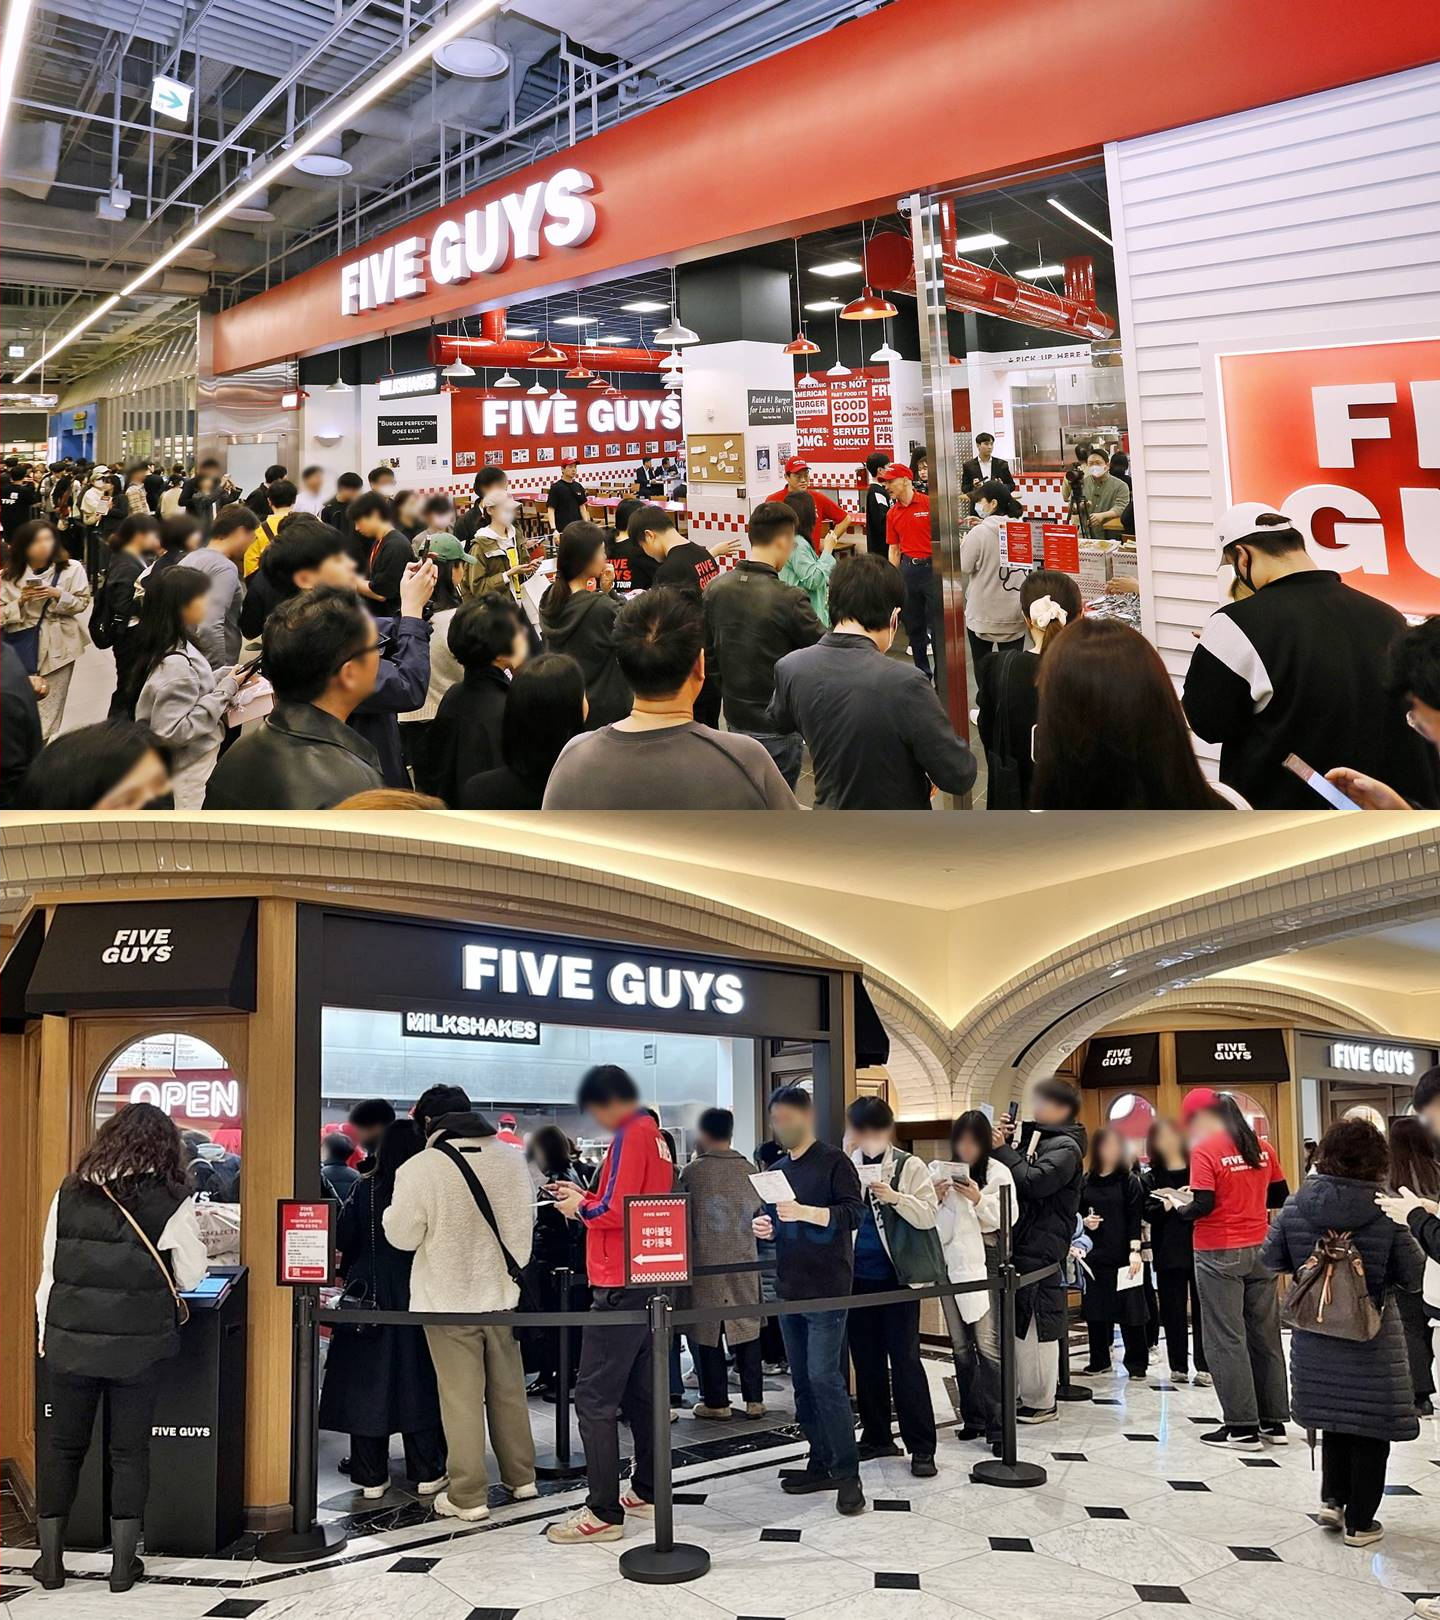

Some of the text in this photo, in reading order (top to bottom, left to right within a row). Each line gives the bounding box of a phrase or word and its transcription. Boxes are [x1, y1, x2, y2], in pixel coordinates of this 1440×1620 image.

[341, 168, 596, 316] FIVE GUYS
[831, 380, 867, 390] IT'S NOT
[774, 396, 791, 405] Burger
[795, 400, 825, 408] BURGER
[833, 400, 866, 411] GOOD
[758, 405, 775, 414] Lunch
[782, 404, 794, 412] NYC
[482, 399, 682, 436] FIVE GUYS
[834, 413, 866, 423] FOOD
[833, 427, 870, 436] SERVED
[833, 438, 870, 446] QUICKLY
[694, 559, 715, 576] FIVE
[113, 929, 171, 946] FIVE
[101, 945, 173, 964] GUYS
[462, 944, 745, 1015] FIVE GUYS
[406, 1011, 537, 1040] MILKSHAKES
[1216, 1043, 1247, 1052] FIVE
[1106, 1048, 1132, 1060] FIVE
[1214, 1051, 1252, 1061] GUYS
[1330, 1043, 1415, 1075] FIVE GUYS
[1102, 1056, 1132, 1067] GUYS
[130, 1080, 239, 1118] OPEN
[1221, 1154, 1244, 1167] FIVE
[641, 1226, 672, 1236] 테이블링
[642, 1237, 672, 1249] 대기등록
[151, 1426, 210, 1437] FIVE GUYS
